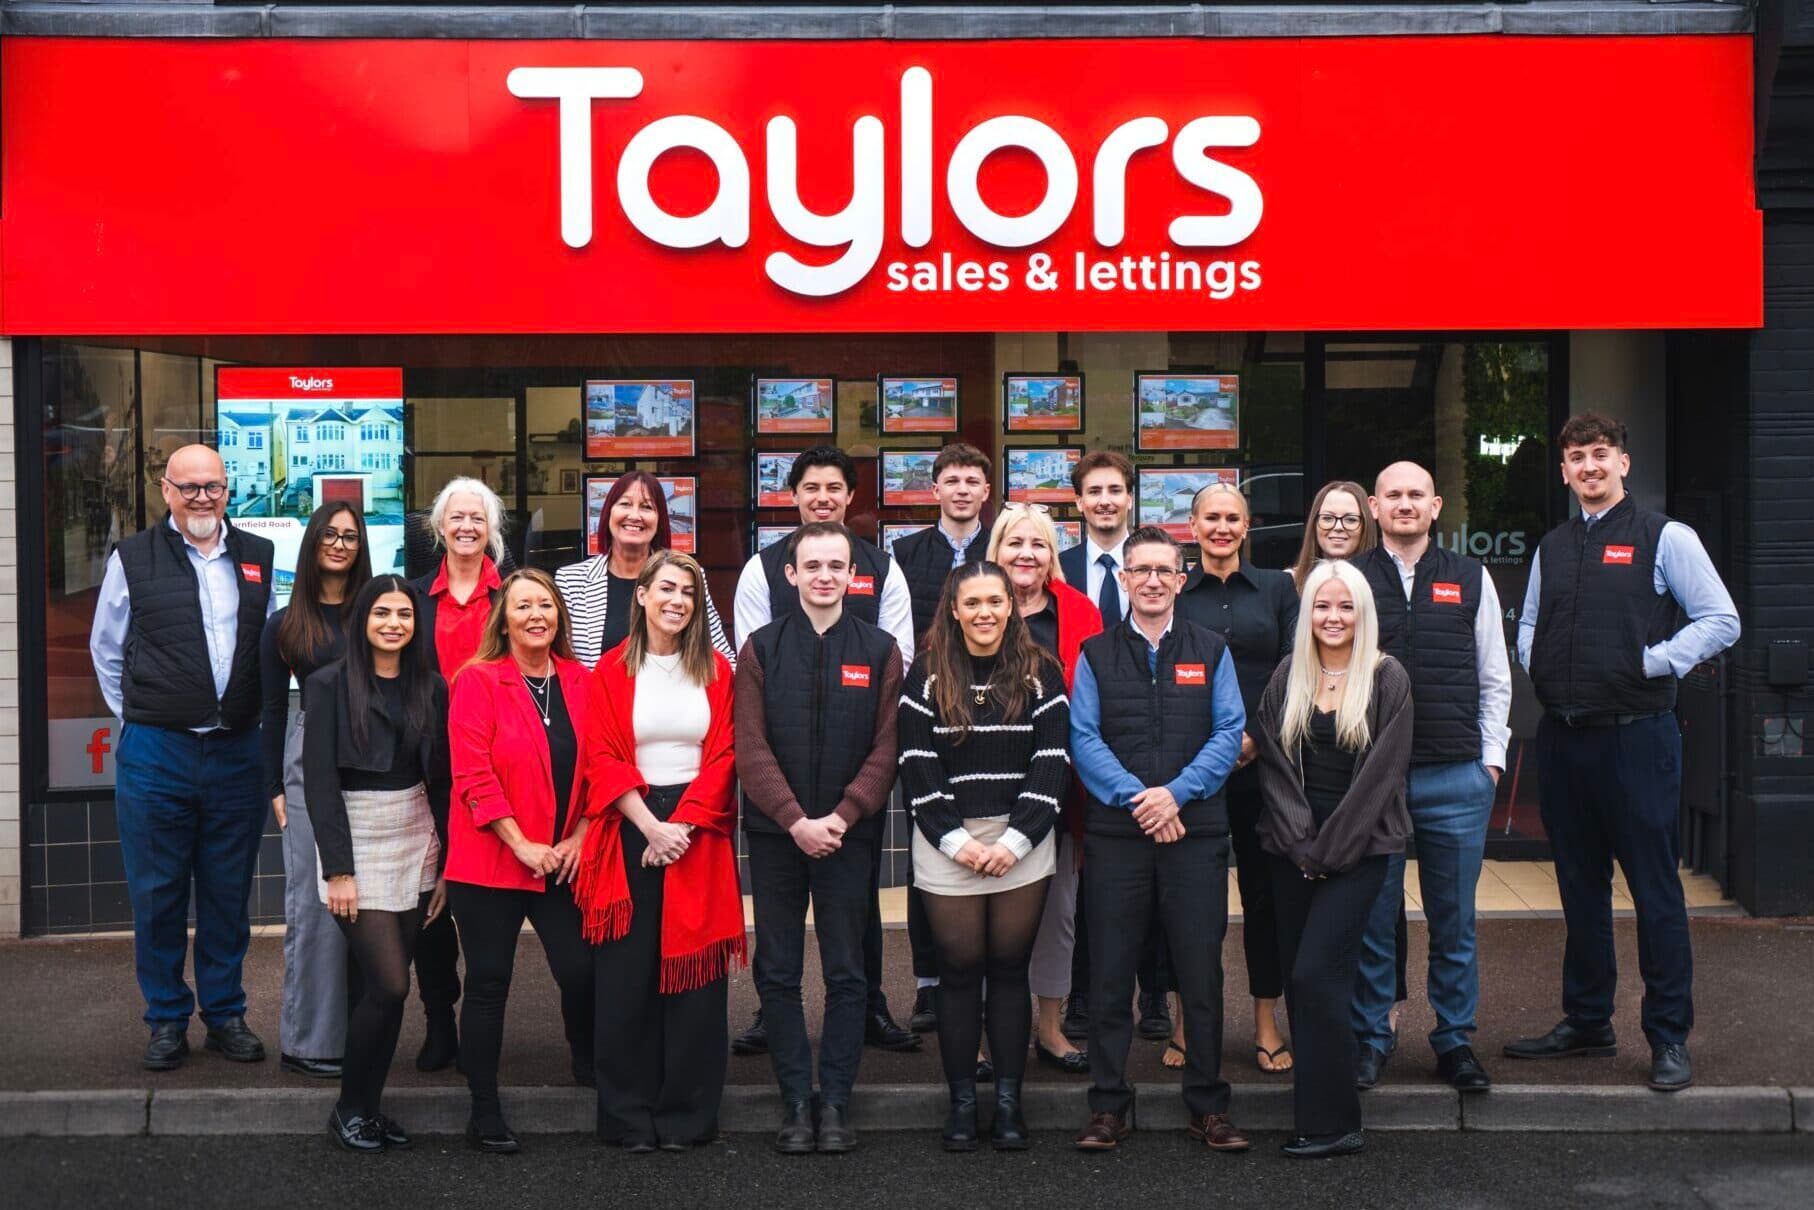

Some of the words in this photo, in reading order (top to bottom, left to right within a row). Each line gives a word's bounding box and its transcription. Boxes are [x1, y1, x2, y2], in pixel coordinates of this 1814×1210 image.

[507, 66, 1263, 297] Taylors
[886, 252, 1010, 292] sales
[1025, 252, 1059, 292] &
[1075, 252, 1262, 300] lettings
[288, 376, 333, 391] Taylors
[233, 521, 266, 529] arnfield
[269, 521, 291, 529] Road
[1437, 523, 1526, 556] ylors
